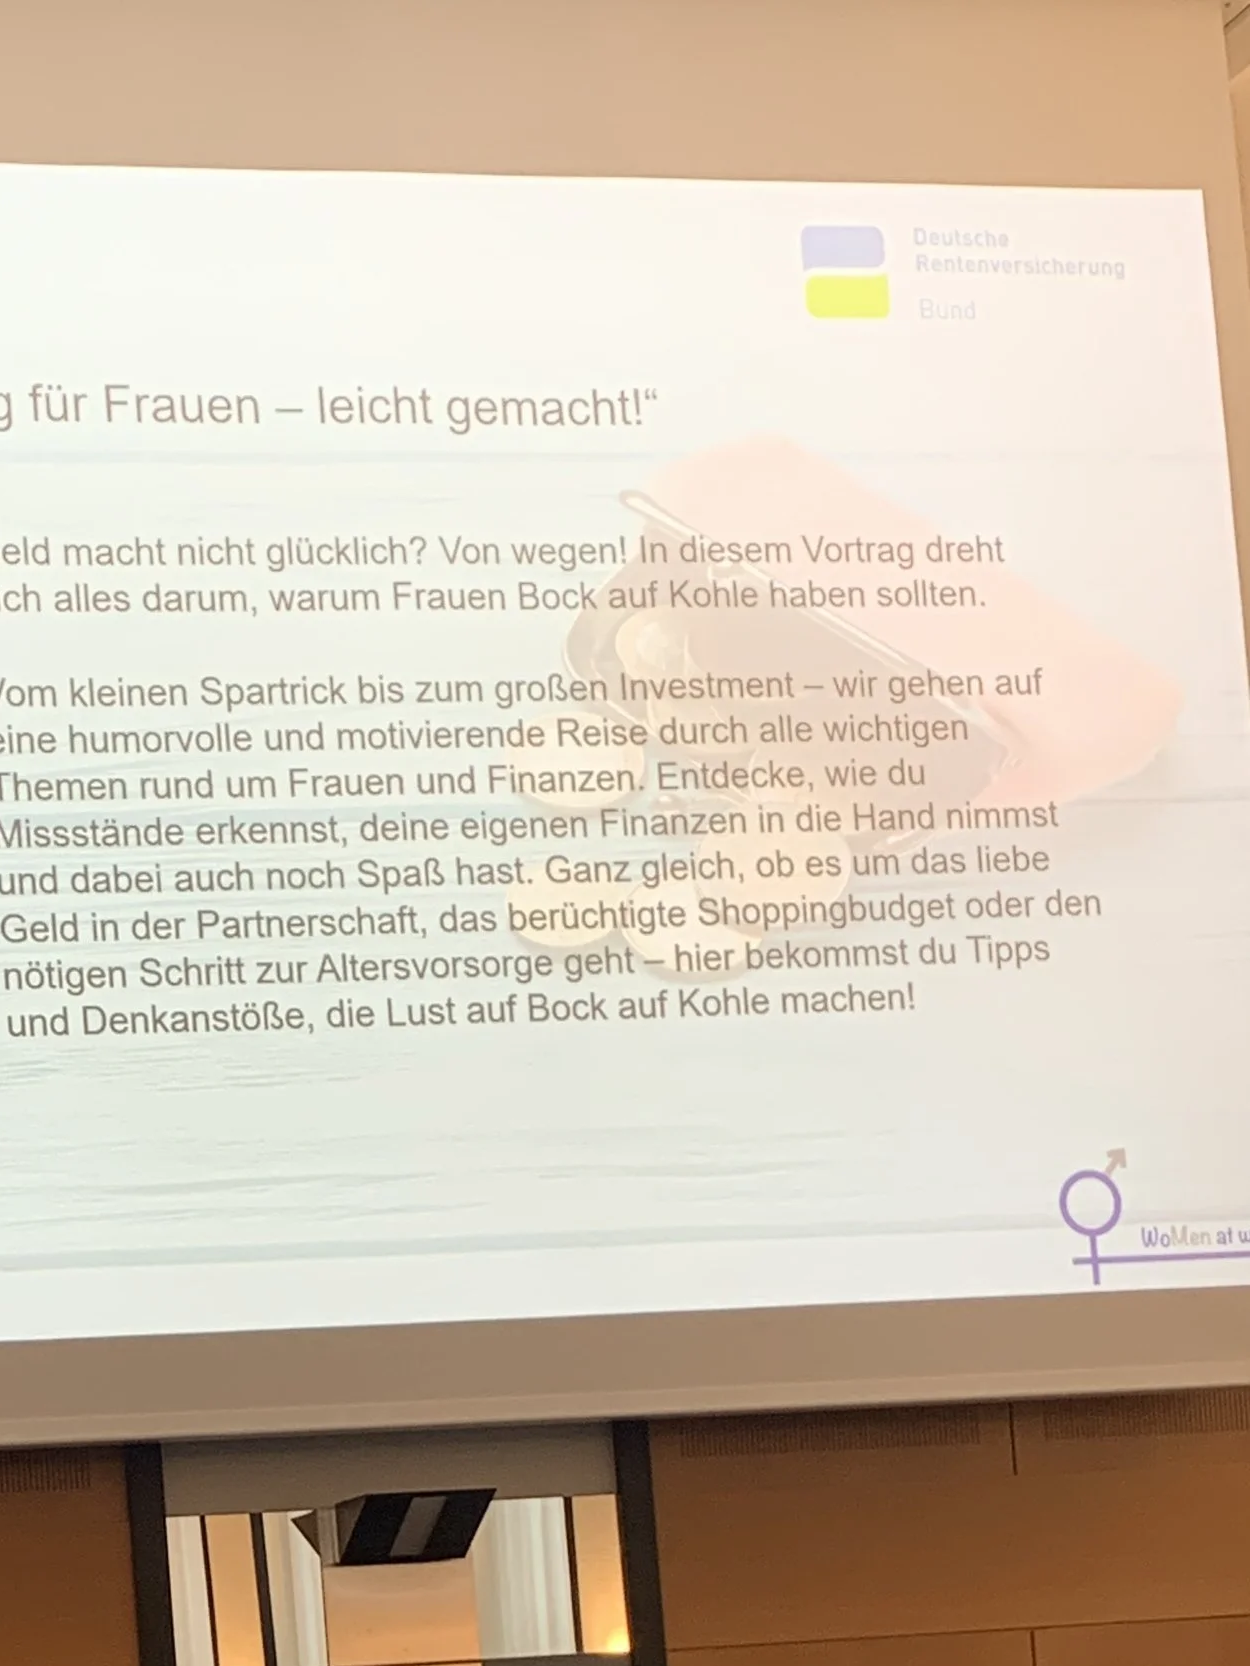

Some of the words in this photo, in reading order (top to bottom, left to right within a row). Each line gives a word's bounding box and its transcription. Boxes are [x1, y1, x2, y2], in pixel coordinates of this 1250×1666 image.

[914, 228, 1008, 247] Deutsche
[916, 255, 1124, 279] Rentenversicherung
[921, 299, 975, 319] Bund
[28, 384, 87, 422] für
[105, 385, 259, 424] Frauen
[318, 386, 432, 424] leicht
[64, 537, 166, 566] macht
[178, 536, 256, 565] nicht
[267, 536, 427, 572] glücklich?
[439, 536, 500, 565] Von
[511, 536, 625, 572] wegen!
[640, 536, 667, 563] In
[680, 535, 791, 563] diesem
[802, 536, 914, 570] Vortrag
[926, 535, 1005, 562] dreht
[55, 583, 130, 612] alles
[143, 583, 257, 616] darum,
[269, 590, 380, 611] warum
[393, 582, 505, 610] Frauen
[518, 582, 597, 610] Bock
[609, 580, 658, 609] auf
[670, 580, 758, 608] Kohle
[770, 580, 865, 607] haben
[877, 580, 985, 607] sollten.
[70, 678, 187, 707] kleinen
[201, 676, 347, 712] Spartrick
[358, 675, 404, 704] bis
[416, 681, 483, 703] zum
[495, 674, 607, 709] großen
[621, 672, 794, 701] Investment
[833, 670, 877, 697] wir
[889, 669, 983, 704] gehen
[996, 668, 1042, 695] auf
[69, 723, 252, 753] humorvolle
[265, 722, 324, 751] und
[337, 719, 544, 750] motivierende
[557, 718, 647, 747] Reise
[660, 716, 747, 745] durch
[760, 715, 812, 743] alle
[823, 714, 968, 748] wichtigen
[141, 770, 213, 799] rund
[227, 776, 276, 798] um
[289, 768, 404, 797] Frauen
[417, 766, 475, 794] und
[488, 765, 644, 793] Finanzen.
[658, 760, 813, 792] Entdecke,
[825, 758, 876, 787] wie
[888, 758, 925, 785] du
[196, 816, 347, 847] erkennst,
[360, 812, 448, 841] deine
[461, 811, 587, 846] eigenen
[600, 808, 746, 836] Finanzen
[759, 805, 784, 833] in
[796, 804, 841, 832] die
[853, 802, 934, 831] Hand
[947, 801, 1058, 829] nimmst
[71, 863, 162, 893] dabei
[175, 862, 254, 892] auch
[267, 860, 345, 890] noch
[358, 858, 445, 895] Spaß
[456, 857, 532, 885] hast.
[546, 855, 631, 883] Ganz
[642, 851, 744, 889] gleich,
[756, 850, 794, 878] ob
[806, 856, 841, 877] es
[853, 855, 899, 875] um
[912, 847, 966, 874] das
[977, 845, 1049, 872] liebe
[1, 913, 78, 943] Geld
[92, 913, 119, 941] in
[132, 911, 186, 940] der
[198, 905, 426, 939] Partnerschaft,
[440, 904, 497, 932] das
[509, 900, 686, 935] berüchtigte
[699, 894, 955, 931] Shoppingbudget
[966, 891, 1034, 918] oder
[1046, 889, 1101, 916] den
[4, 960, 126, 996] nötigen
[140, 956, 246, 987] Schritt
[257, 962, 308, 984] zur
[317, 953, 552, 984] Altersvorsorge
[564, 946, 635, 982] geht
[675, 944, 734, 972] hier
[746, 940, 909, 969] bekommst
[919, 937, 956, 964] du
[966, 935, 1050, 970] Tipps
[8, 1006, 69, 1037] und
[82, 1001, 313, 1035] Denkanstöße,
[327, 999, 374, 1028] die
[387, 998, 456, 1026] Lust
[467, 994, 517, 1023] auf
[528, 992, 608, 1022] Bock
[619, 990, 667, 1019] auf
[679, 987, 769, 1017] Kohle
[782, 982, 914, 1013] machen!
[1217, 1228, 1232, 1245] at
